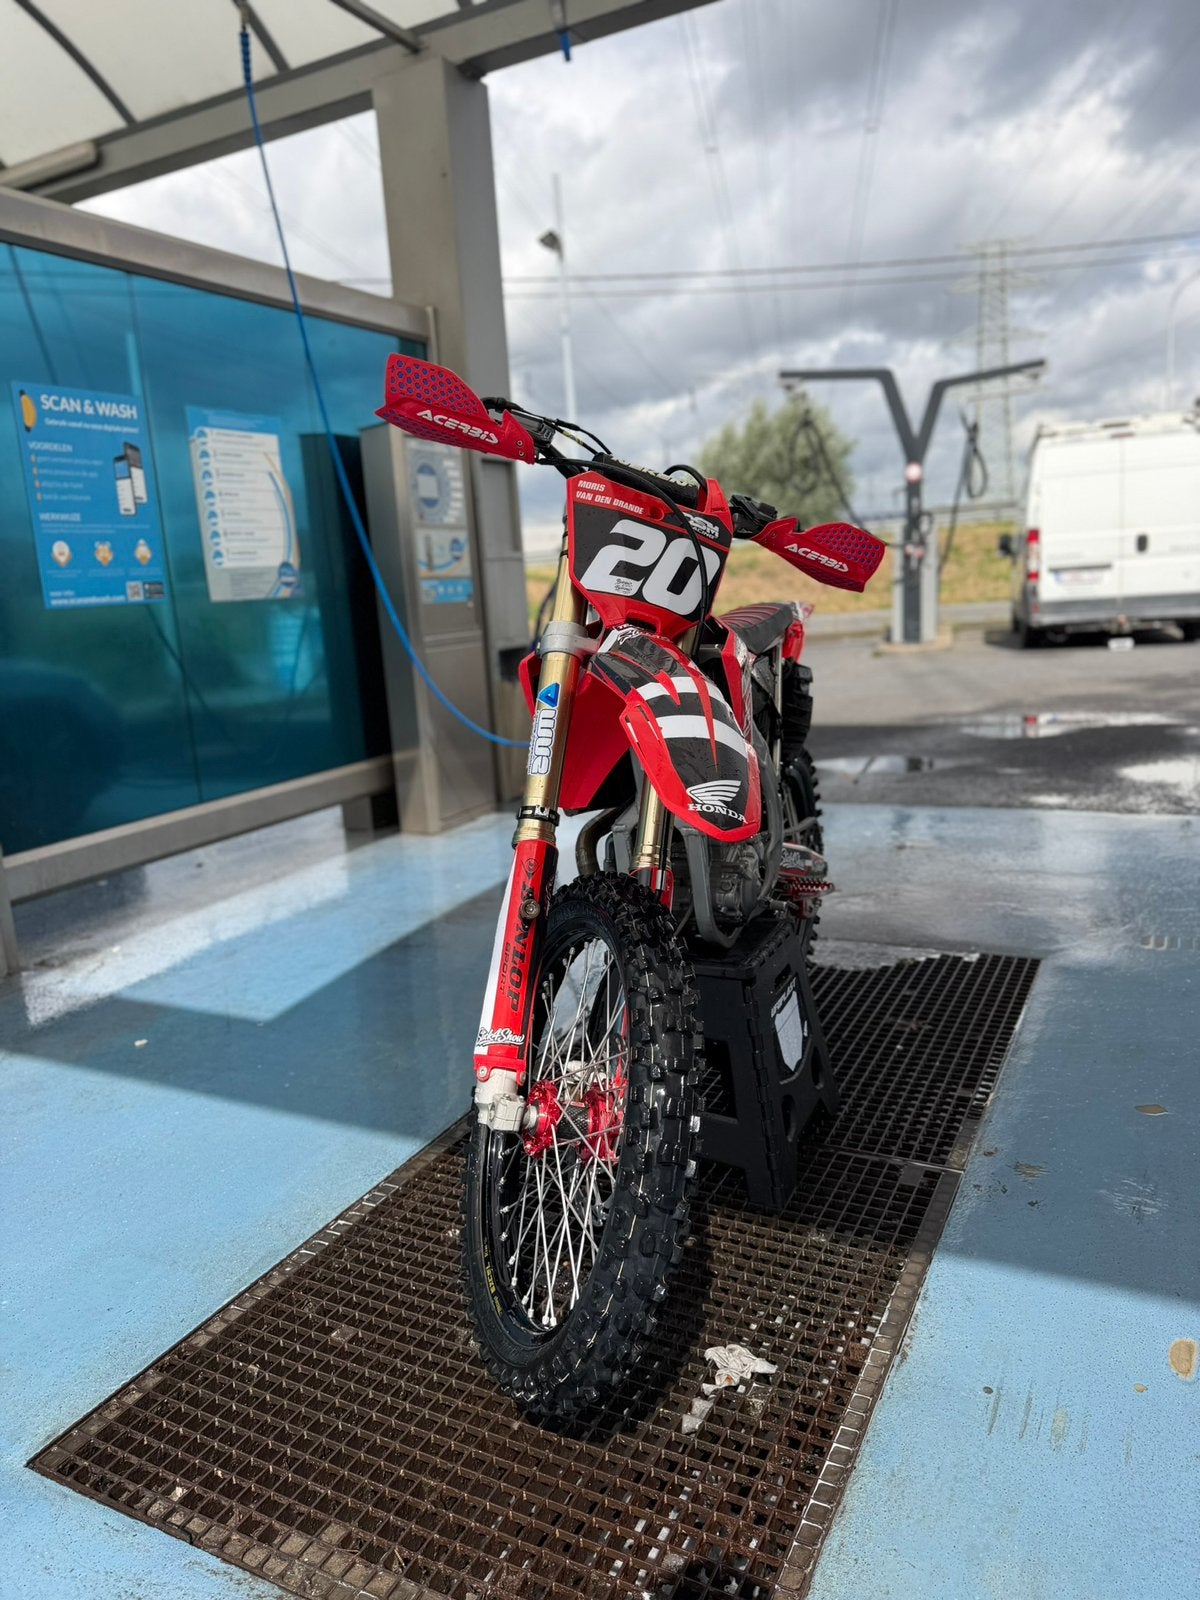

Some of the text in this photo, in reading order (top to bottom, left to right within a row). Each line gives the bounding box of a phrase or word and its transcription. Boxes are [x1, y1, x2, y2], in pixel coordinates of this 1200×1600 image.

[40, 394, 138, 419] SCAN & WASH
[578, 480, 606, 492] MORIS
[576, 491, 645, 515] VAN DEN BRANDE
[580, 519, 721, 615] 20
[687, 803, 749, 825] HONDA
[506, 881, 535, 1013] DNLOP
[500, 943, 509, 995] SPORT
